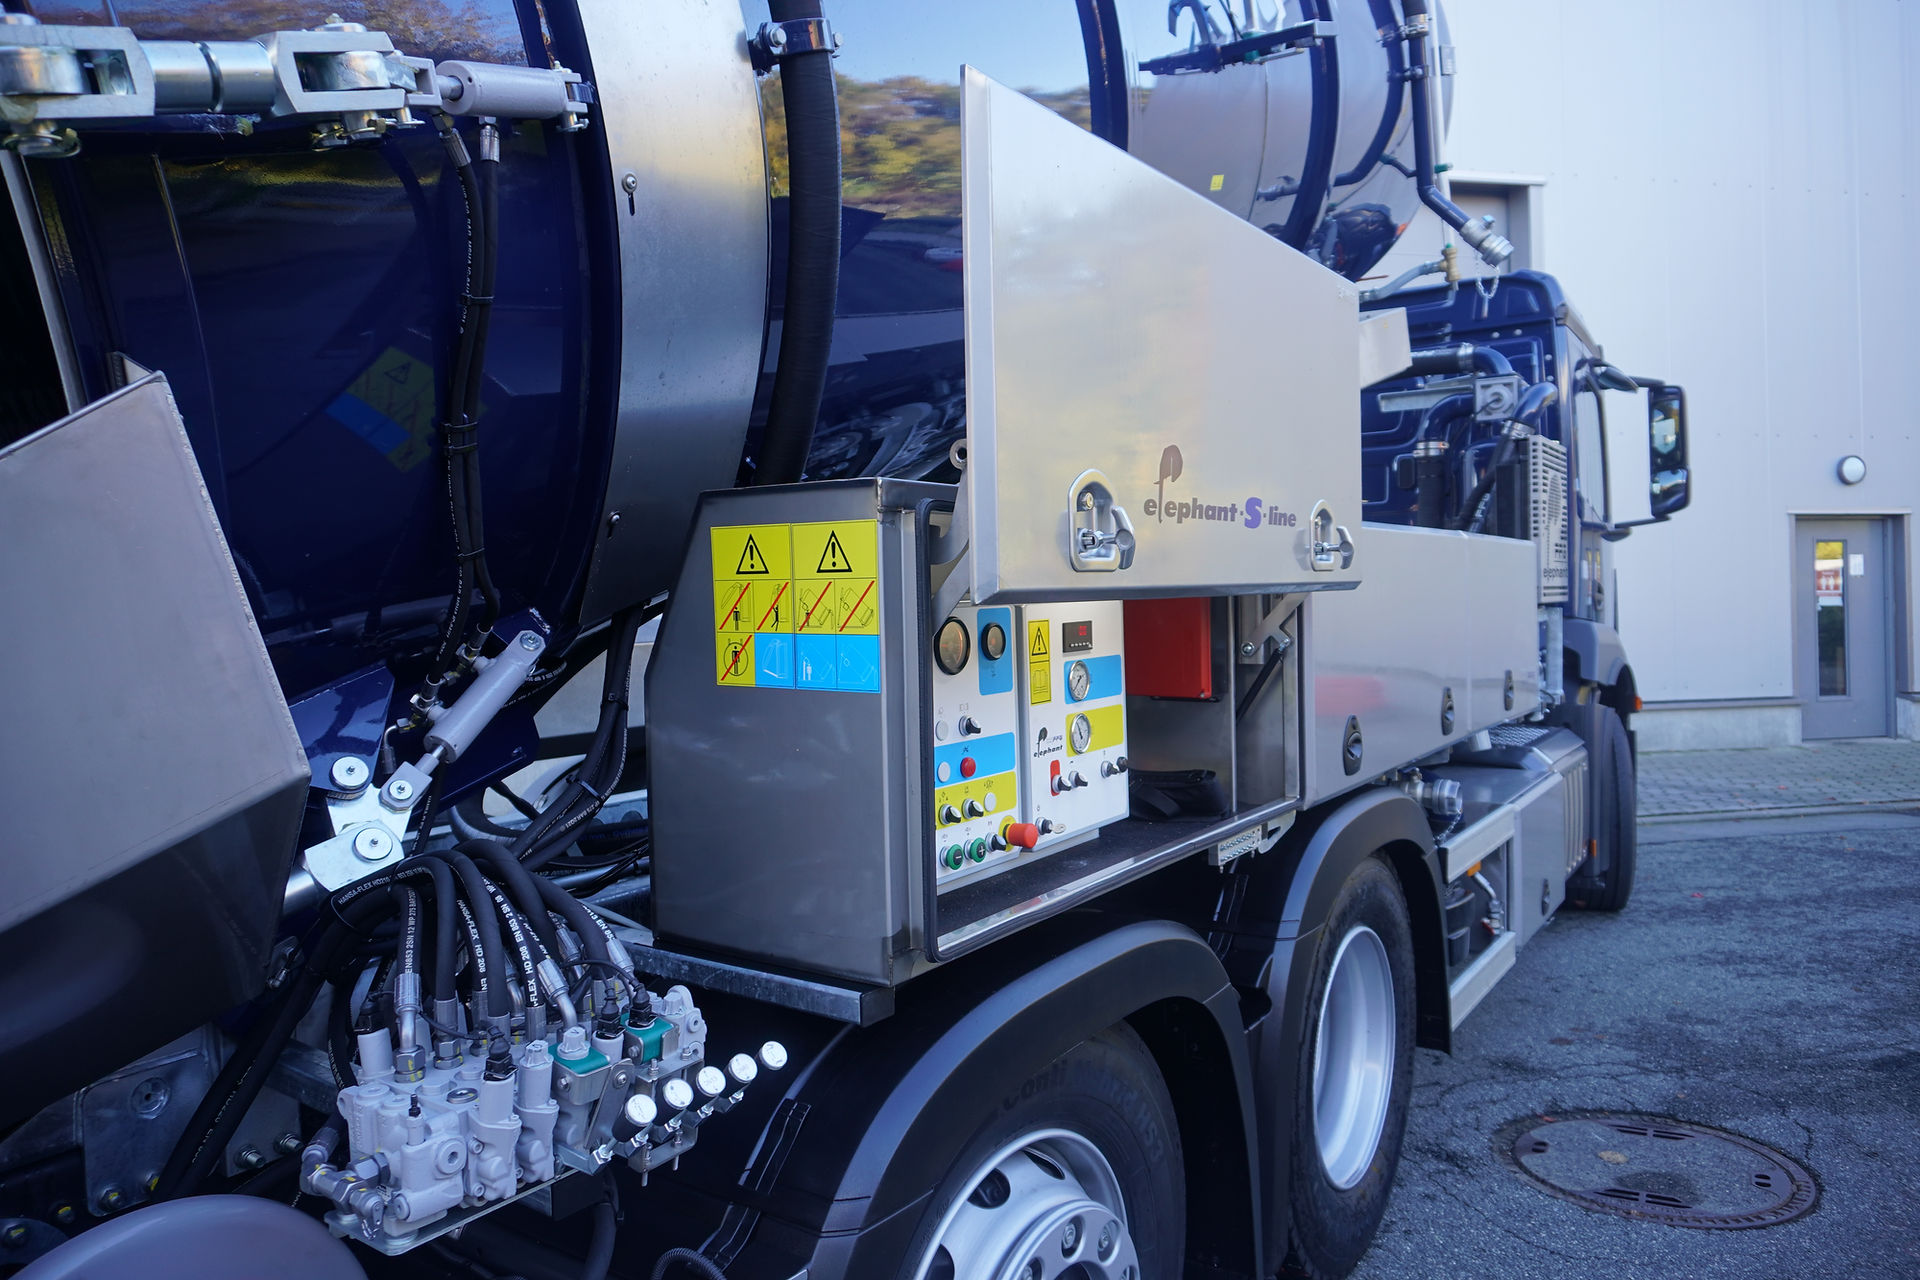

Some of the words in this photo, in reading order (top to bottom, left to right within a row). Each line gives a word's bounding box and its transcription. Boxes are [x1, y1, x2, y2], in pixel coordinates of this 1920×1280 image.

[1144, 496, 1238, 524] elephant
[1268, 505, 1297, 527] line
[338, 881, 374, 905] HANSA-FLEX
[457, 899, 480, 940] HANSA-FLEX
[595, 919, 608, 930] EN
[513, 930, 524, 943] EN
[475, 944, 484, 957] HD
[519, 945, 530, 961] 208
[477, 957, 486, 973] 208
[523, 961, 534, 975] HD
